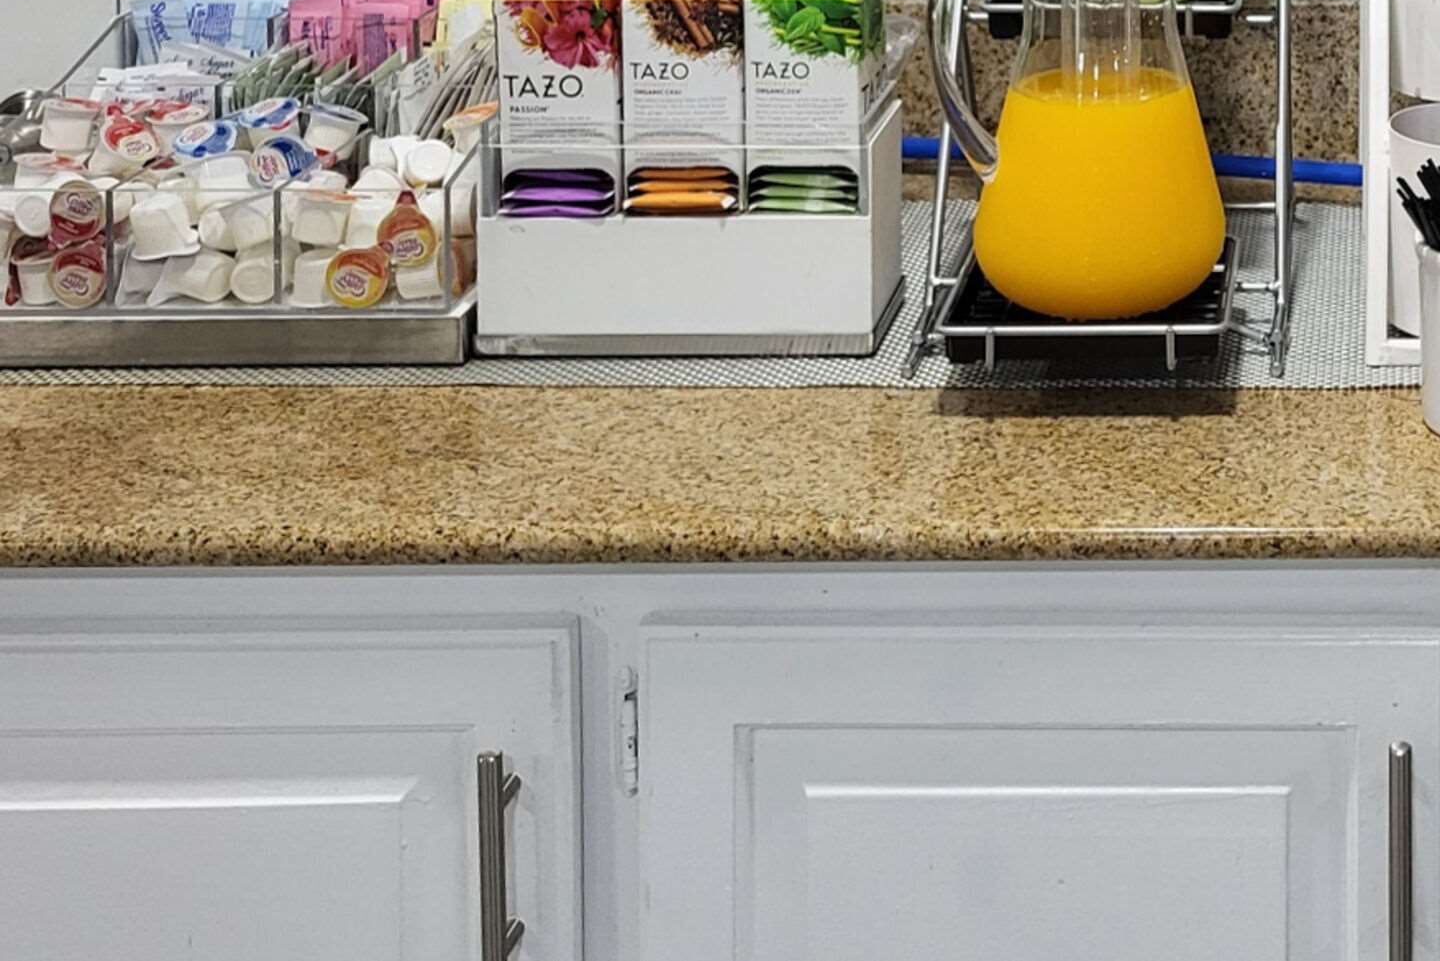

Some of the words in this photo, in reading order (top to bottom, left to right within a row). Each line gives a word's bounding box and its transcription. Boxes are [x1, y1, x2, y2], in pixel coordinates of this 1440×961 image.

[629, 61, 690, 81] TAZO
[750, 61, 811, 80] TAZO
[502, 73, 583, 98] TAZO
